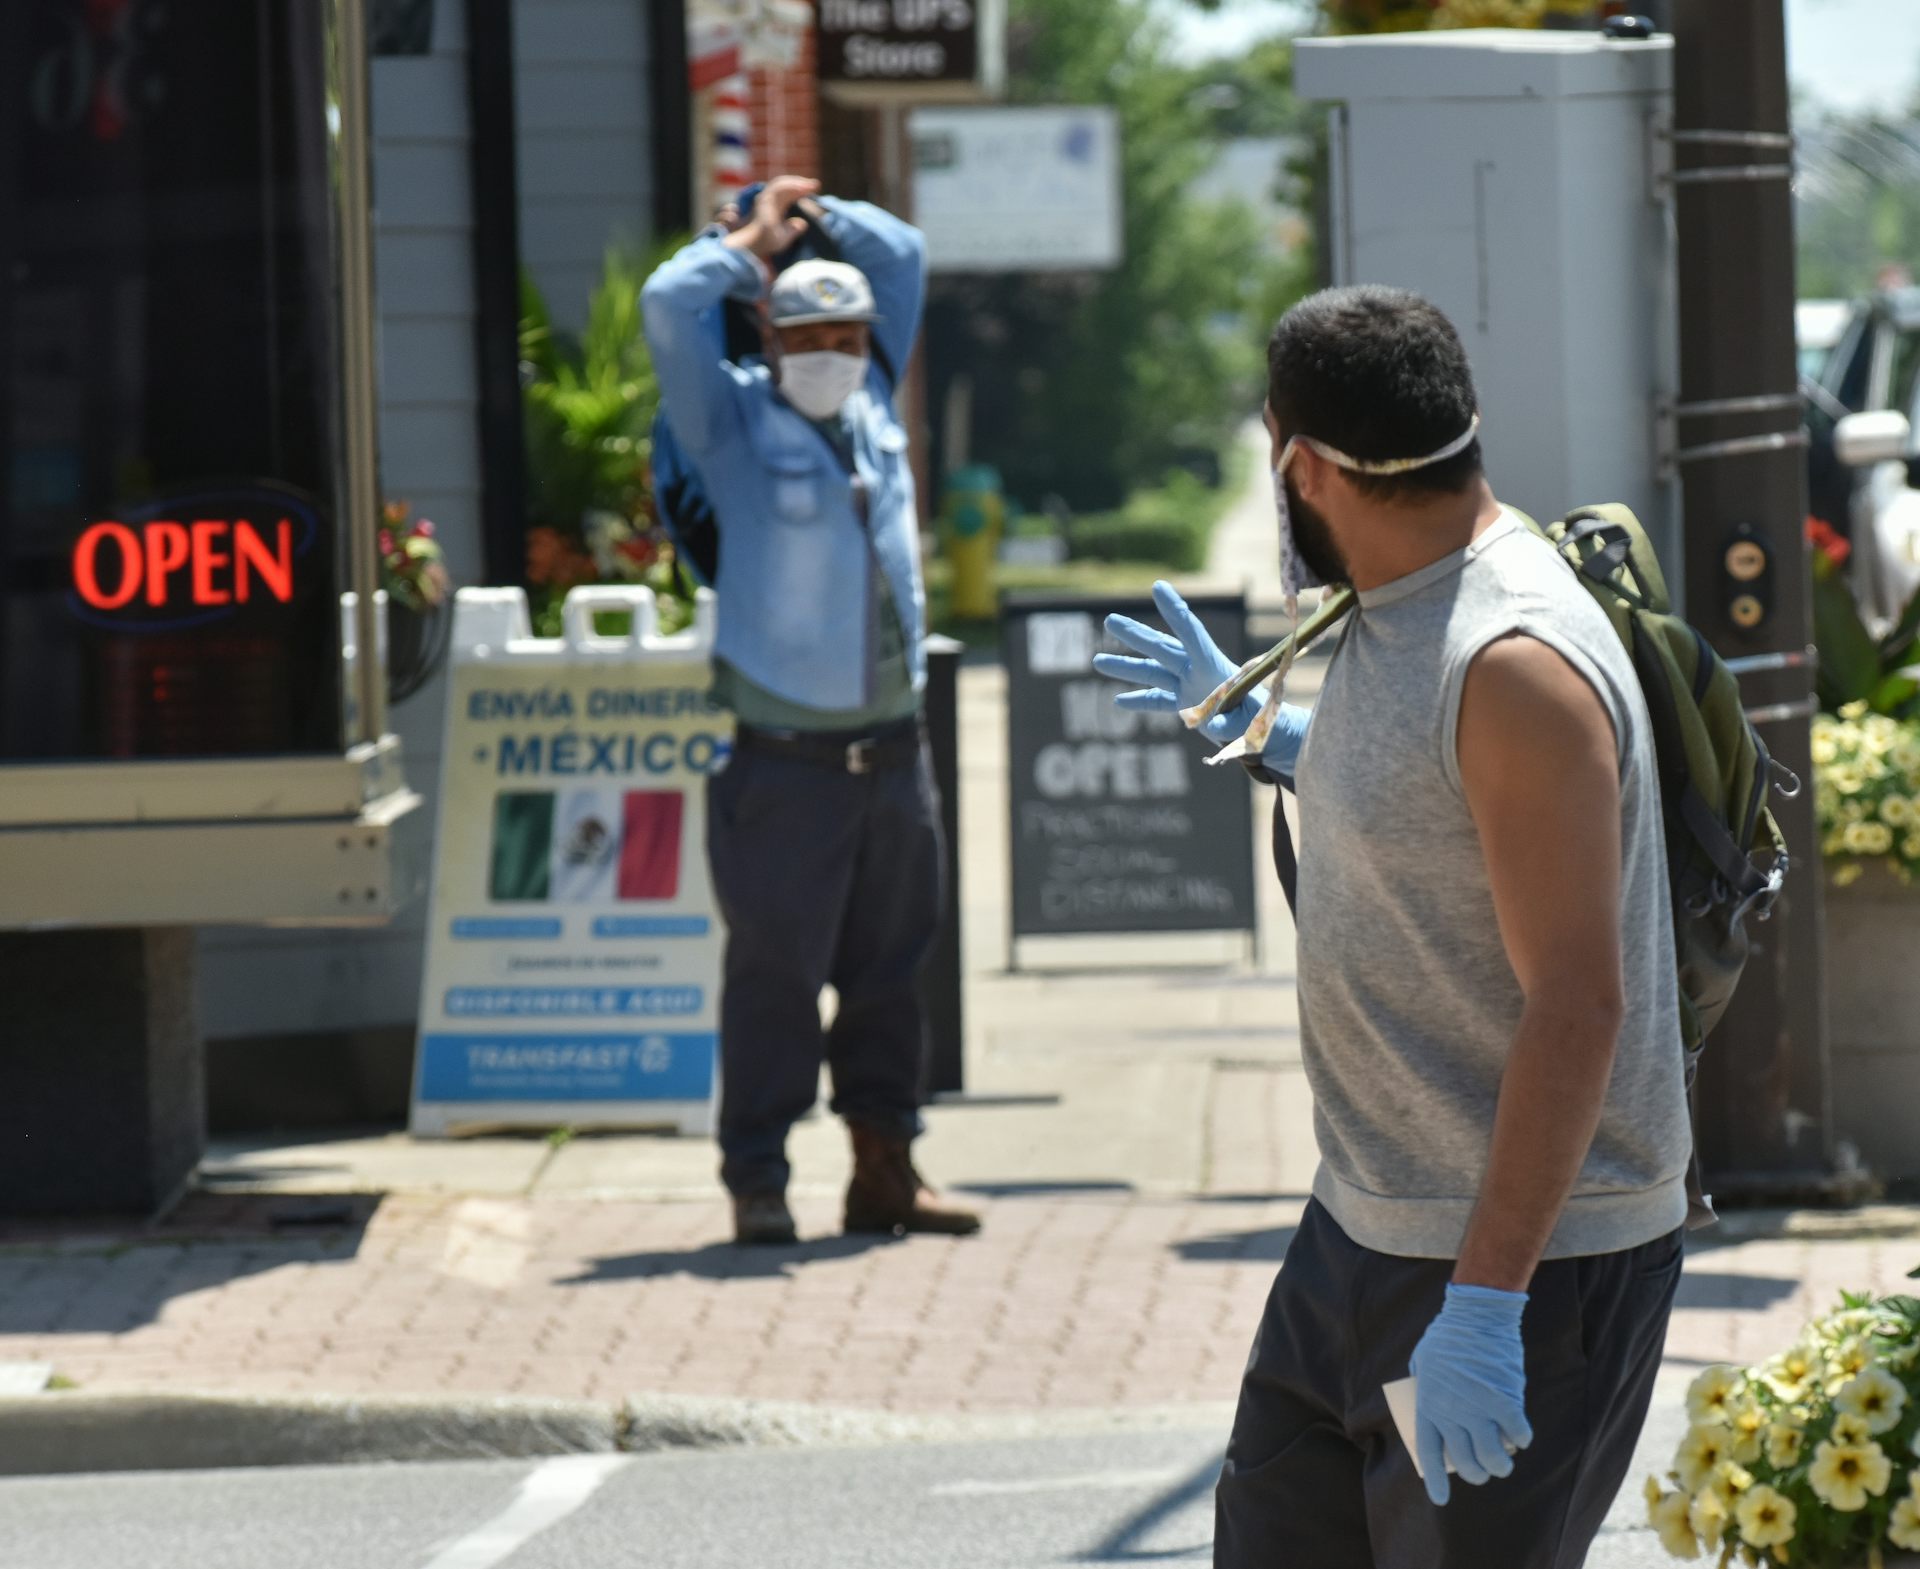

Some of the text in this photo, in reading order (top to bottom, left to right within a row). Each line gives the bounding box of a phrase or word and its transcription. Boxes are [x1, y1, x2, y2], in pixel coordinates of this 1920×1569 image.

[844, 35, 945, 77] Store
[73, 518, 293, 609] OPEN
[468, 683, 574, 720] ENVÍA
[498, 724, 717, 775] MÉXICO
[1034, 743, 1190, 798] OPEN
[468, 1044, 631, 1071] TRANSFAST
